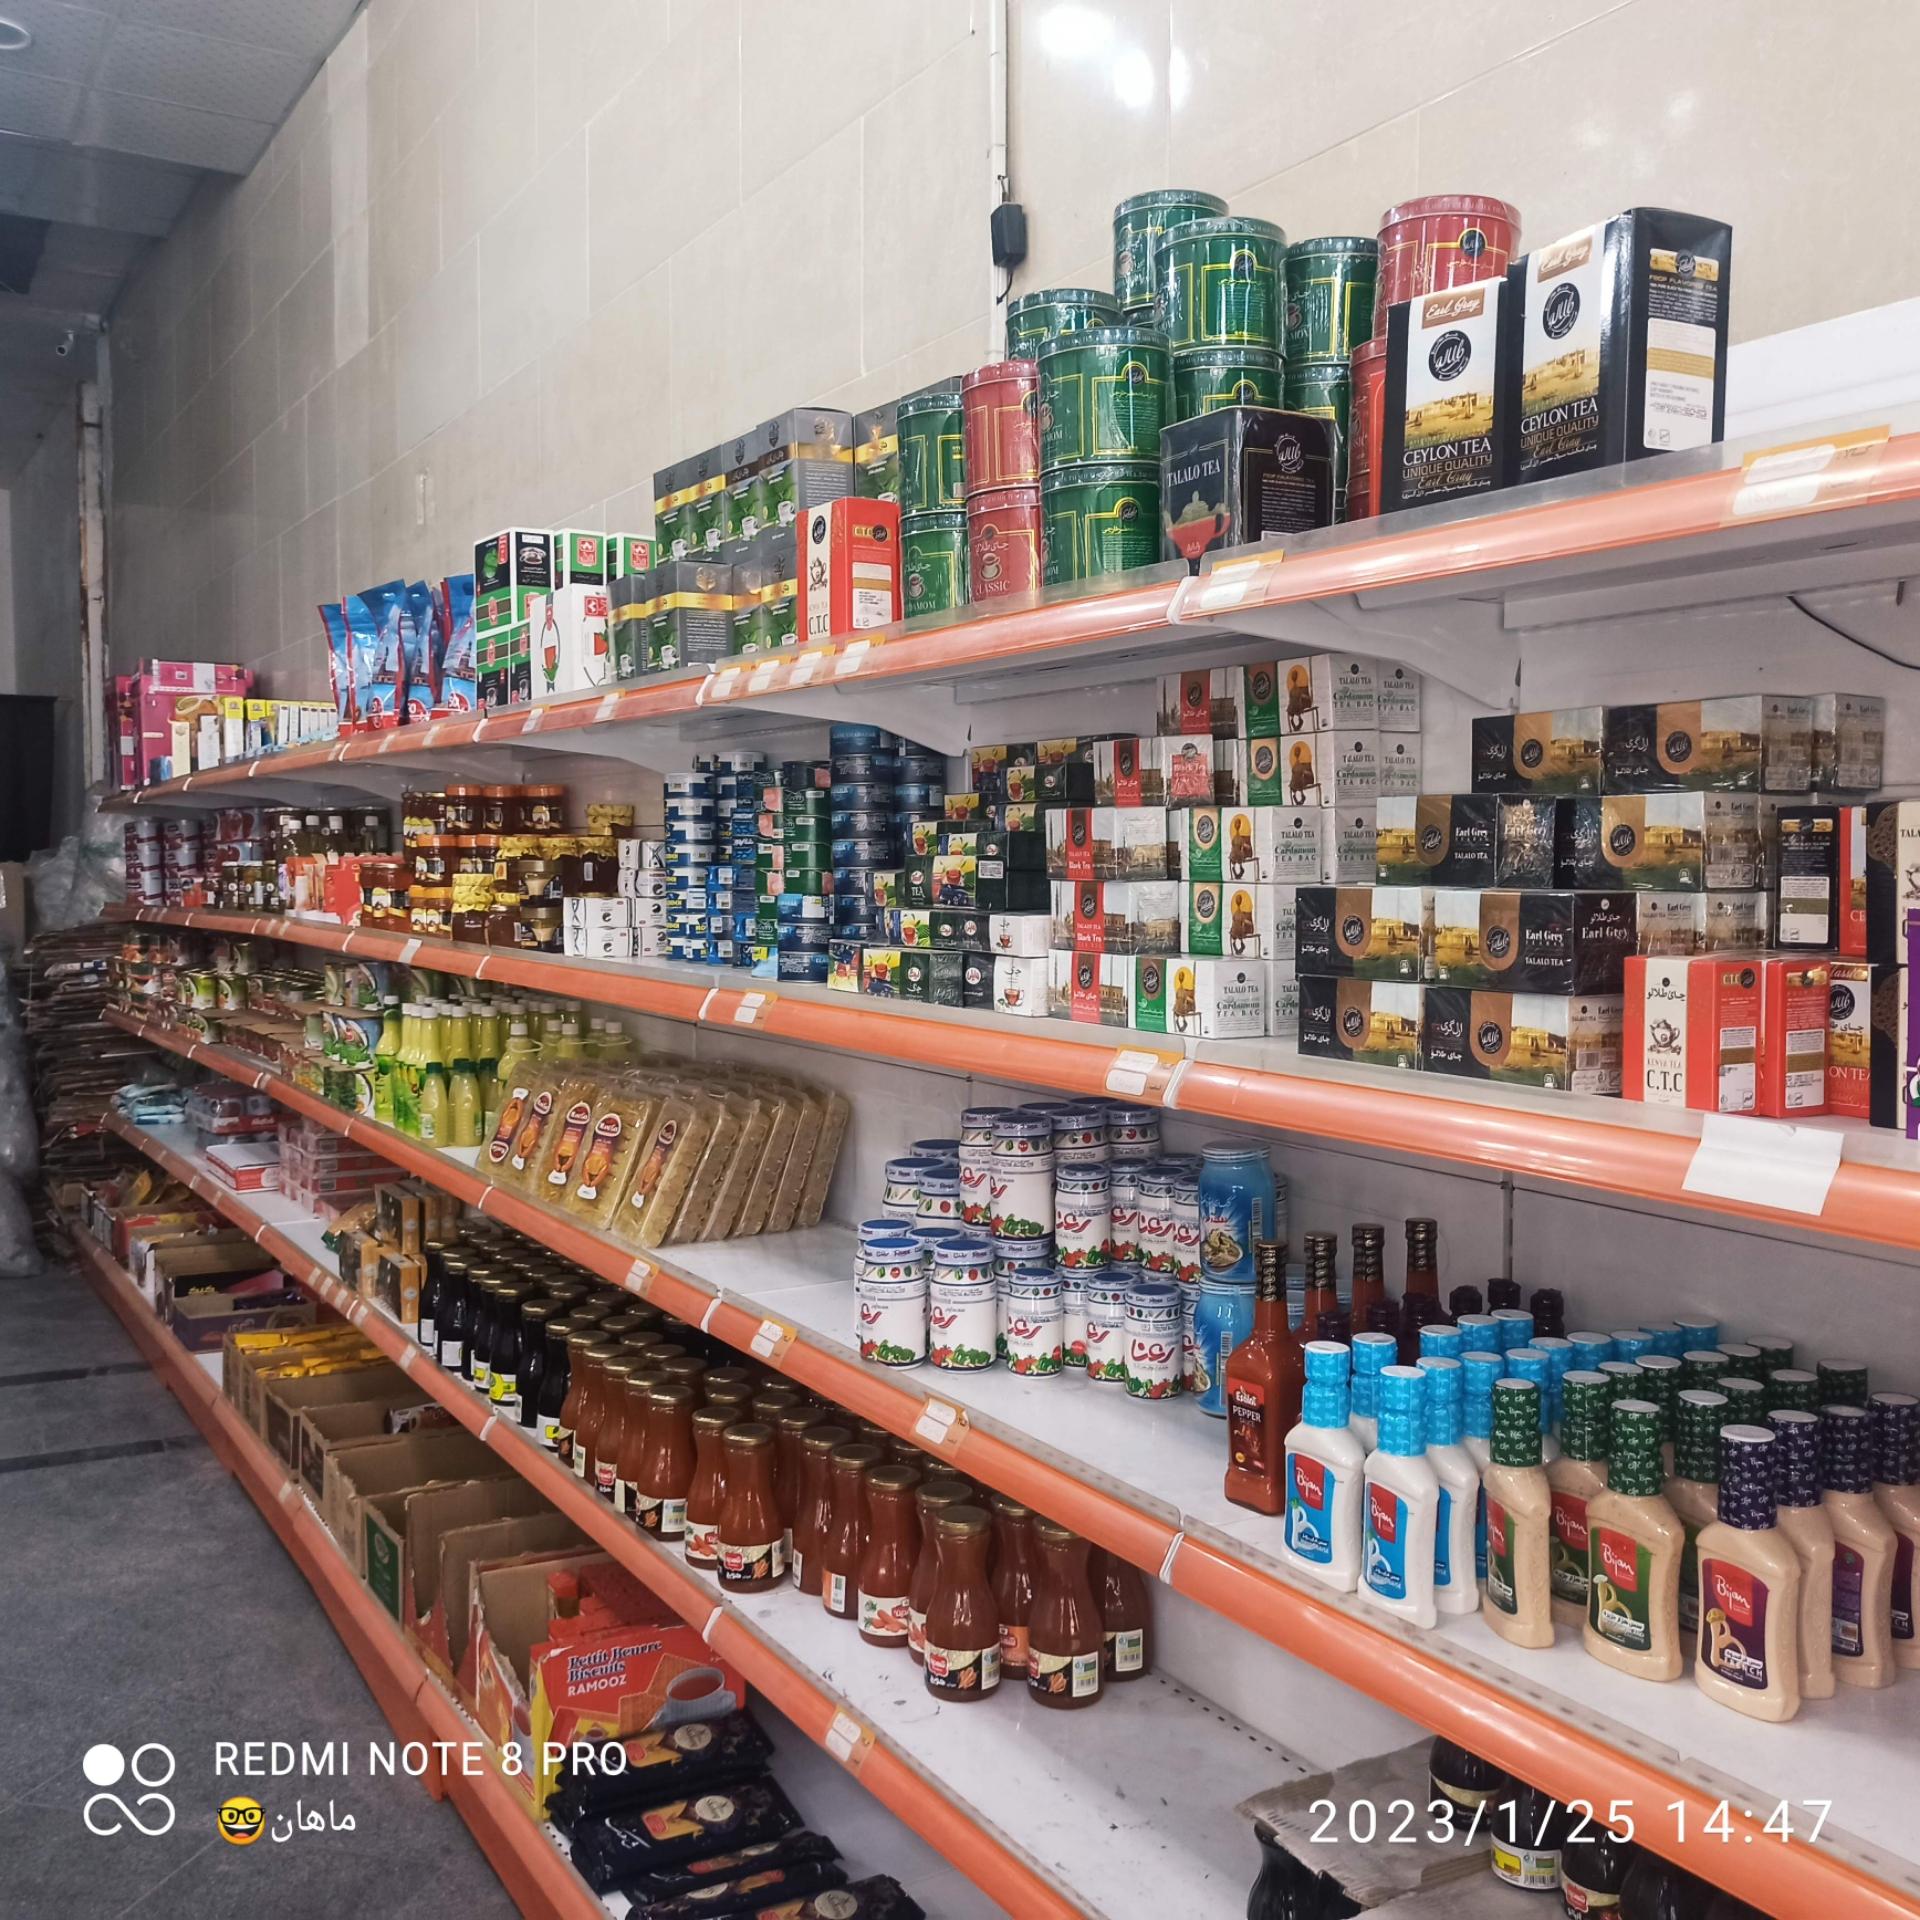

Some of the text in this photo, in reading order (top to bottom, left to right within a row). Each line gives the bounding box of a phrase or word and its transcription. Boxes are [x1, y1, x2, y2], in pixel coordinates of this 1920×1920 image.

[1521, 397, 1598, 434] CEYLON TEA
[1521, 415, 1598, 448] UNIQUE QUALITY
[1403, 438, 1491, 466] CEYLON TEA
[1167, 458, 1220, 487] TALALO TEA
[1403, 454, 1492, 480] UNIQUE QUALITY
[809, 613, 829, 635] C.T.C
[1364, 754, 1375, 762] TEA
[1281, 831, 1303, 839] TALALO
[1344, 831, 1364, 839] TALALO
[1456, 827, 1470, 836] Earl
[1275, 846, 1316, 854] Cardamom
[911, 887, 926, 898] TEA
[1526, 928, 1542, 940] Earl
[1582, 927, 1603, 939] Earl
[1525, 956, 1564, 967] TALALO TEA
[1224, 986, 1246, 994] TALALO
[1216, 1001, 1260, 1009] Cardamom
[1647, 1069, 1683, 1092] C.T.C
[1131, 1338, 1175, 1363] رعنا
[1233, 1405, 1260, 1422] PEPPER
[1296, 1467, 1322, 1498] Bijan
[1370, 1496, 1394, 1529] Bijan
[1555, 1506, 1588, 1537] Bijan
[1602, 1542, 1634, 1576] Bijan
[1714, 1574, 1750, 1610] Bijan
[611, 1641, 662, 1661] Beurre
[568, 1660, 625, 1683] Biscuits
[568, 1674, 627, 1697] RAMOOZ
